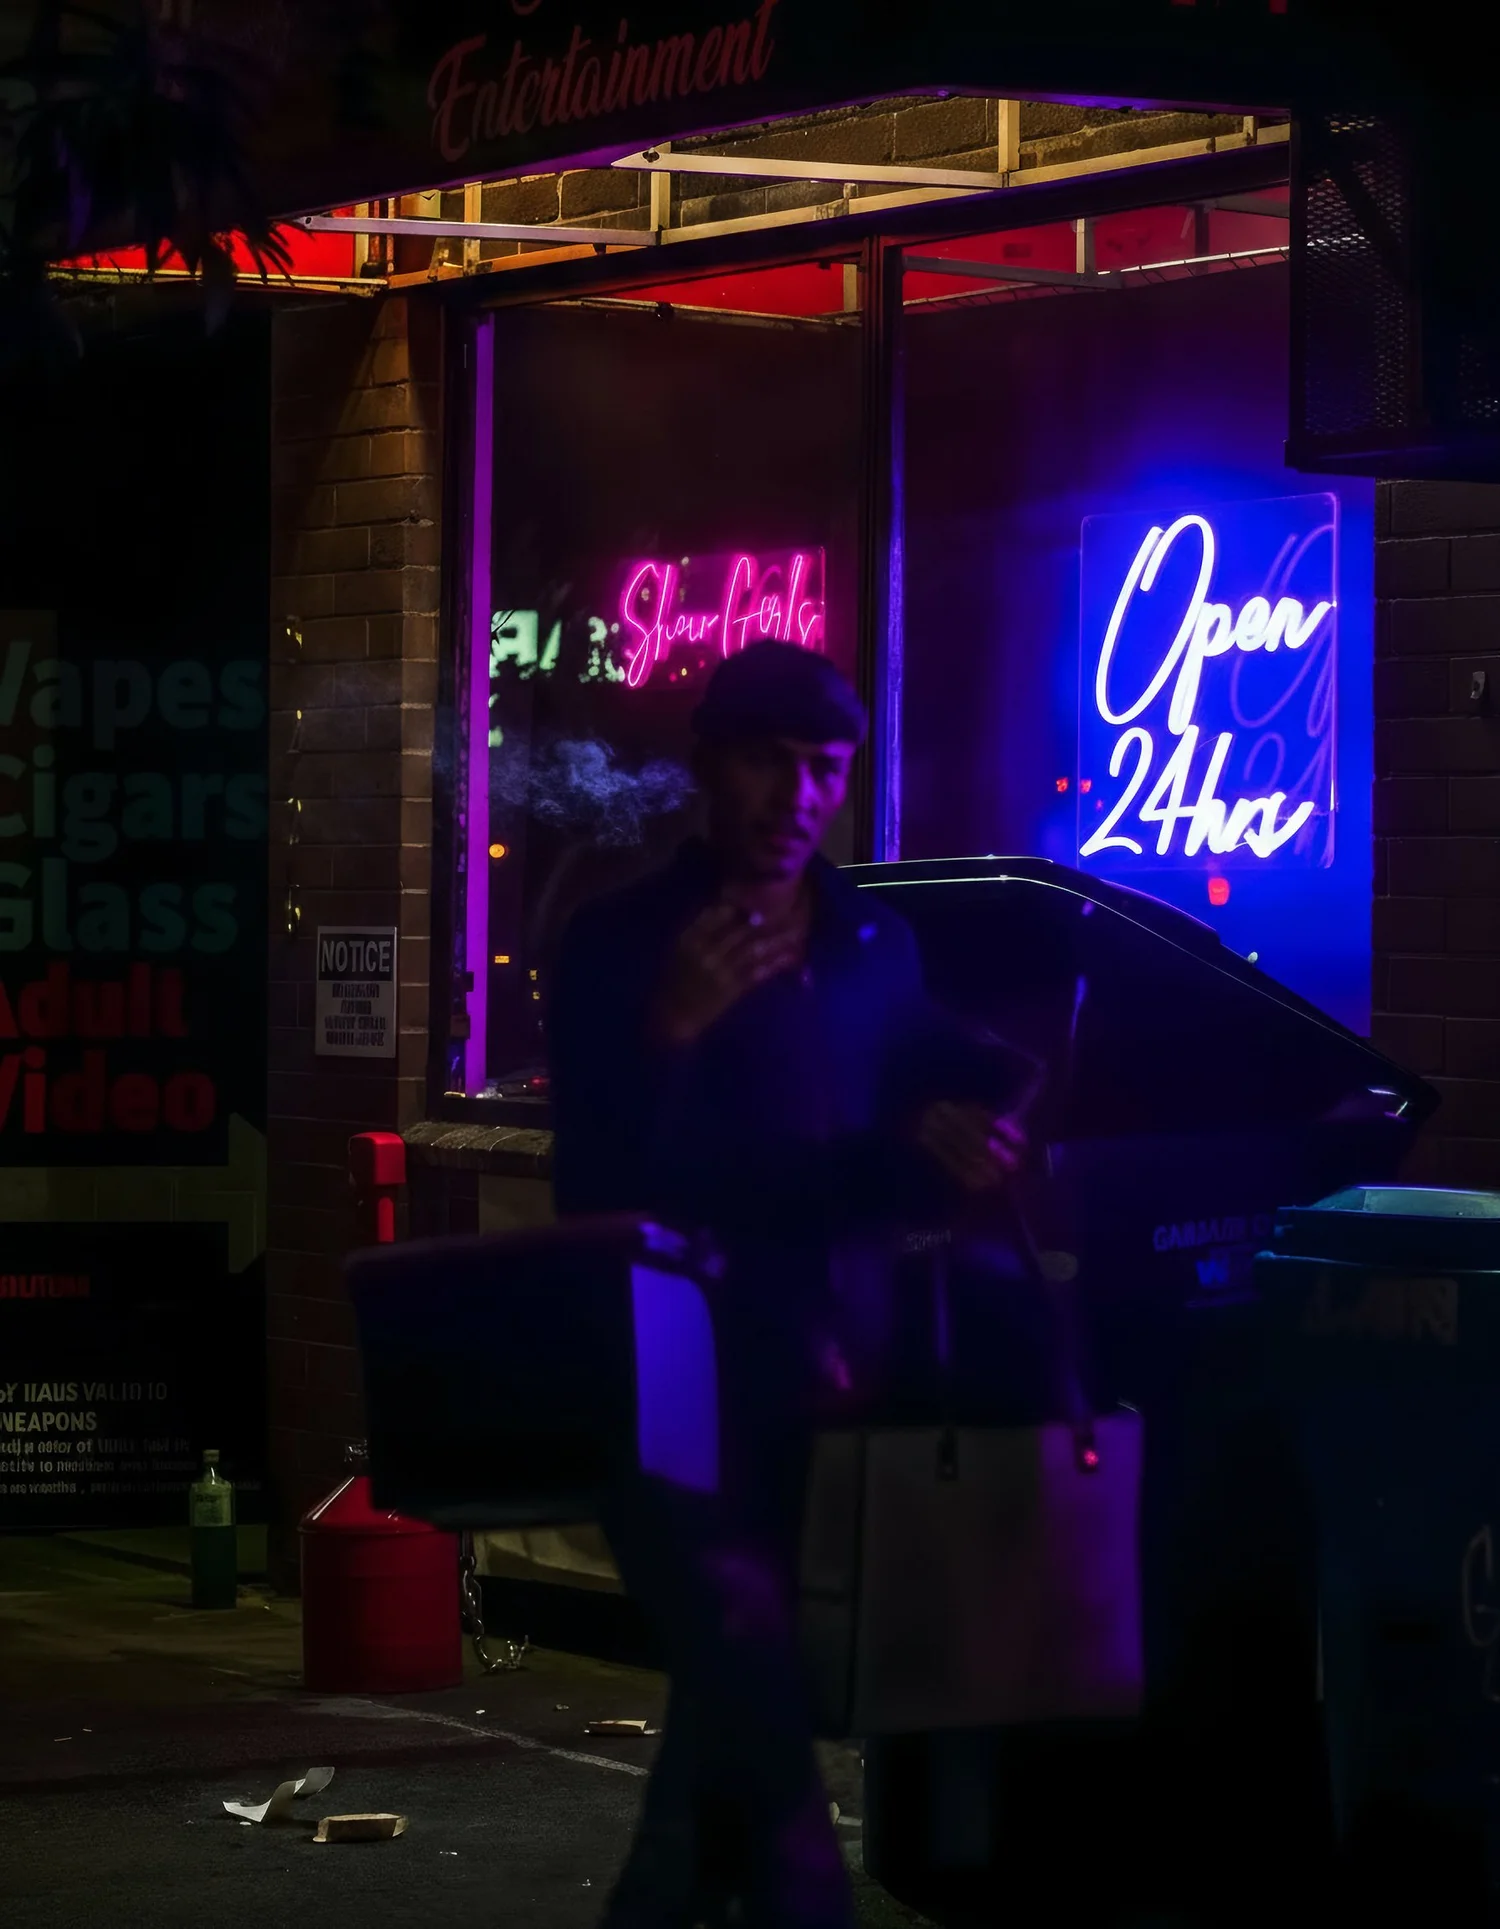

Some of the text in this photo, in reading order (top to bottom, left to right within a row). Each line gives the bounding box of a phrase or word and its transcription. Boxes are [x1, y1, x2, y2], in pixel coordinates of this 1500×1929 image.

[427, 0, 776, 163] Entertainment
[623, 562, 720, 688] Show
[1095, 514, 1337, 735] Open
[1079, 725, 1315, 859] 24hrs
[0, 857, 239, 954] Glass
[320, 940, 391, 973] NOTICE
[0, 957, 190, 1040] dult
